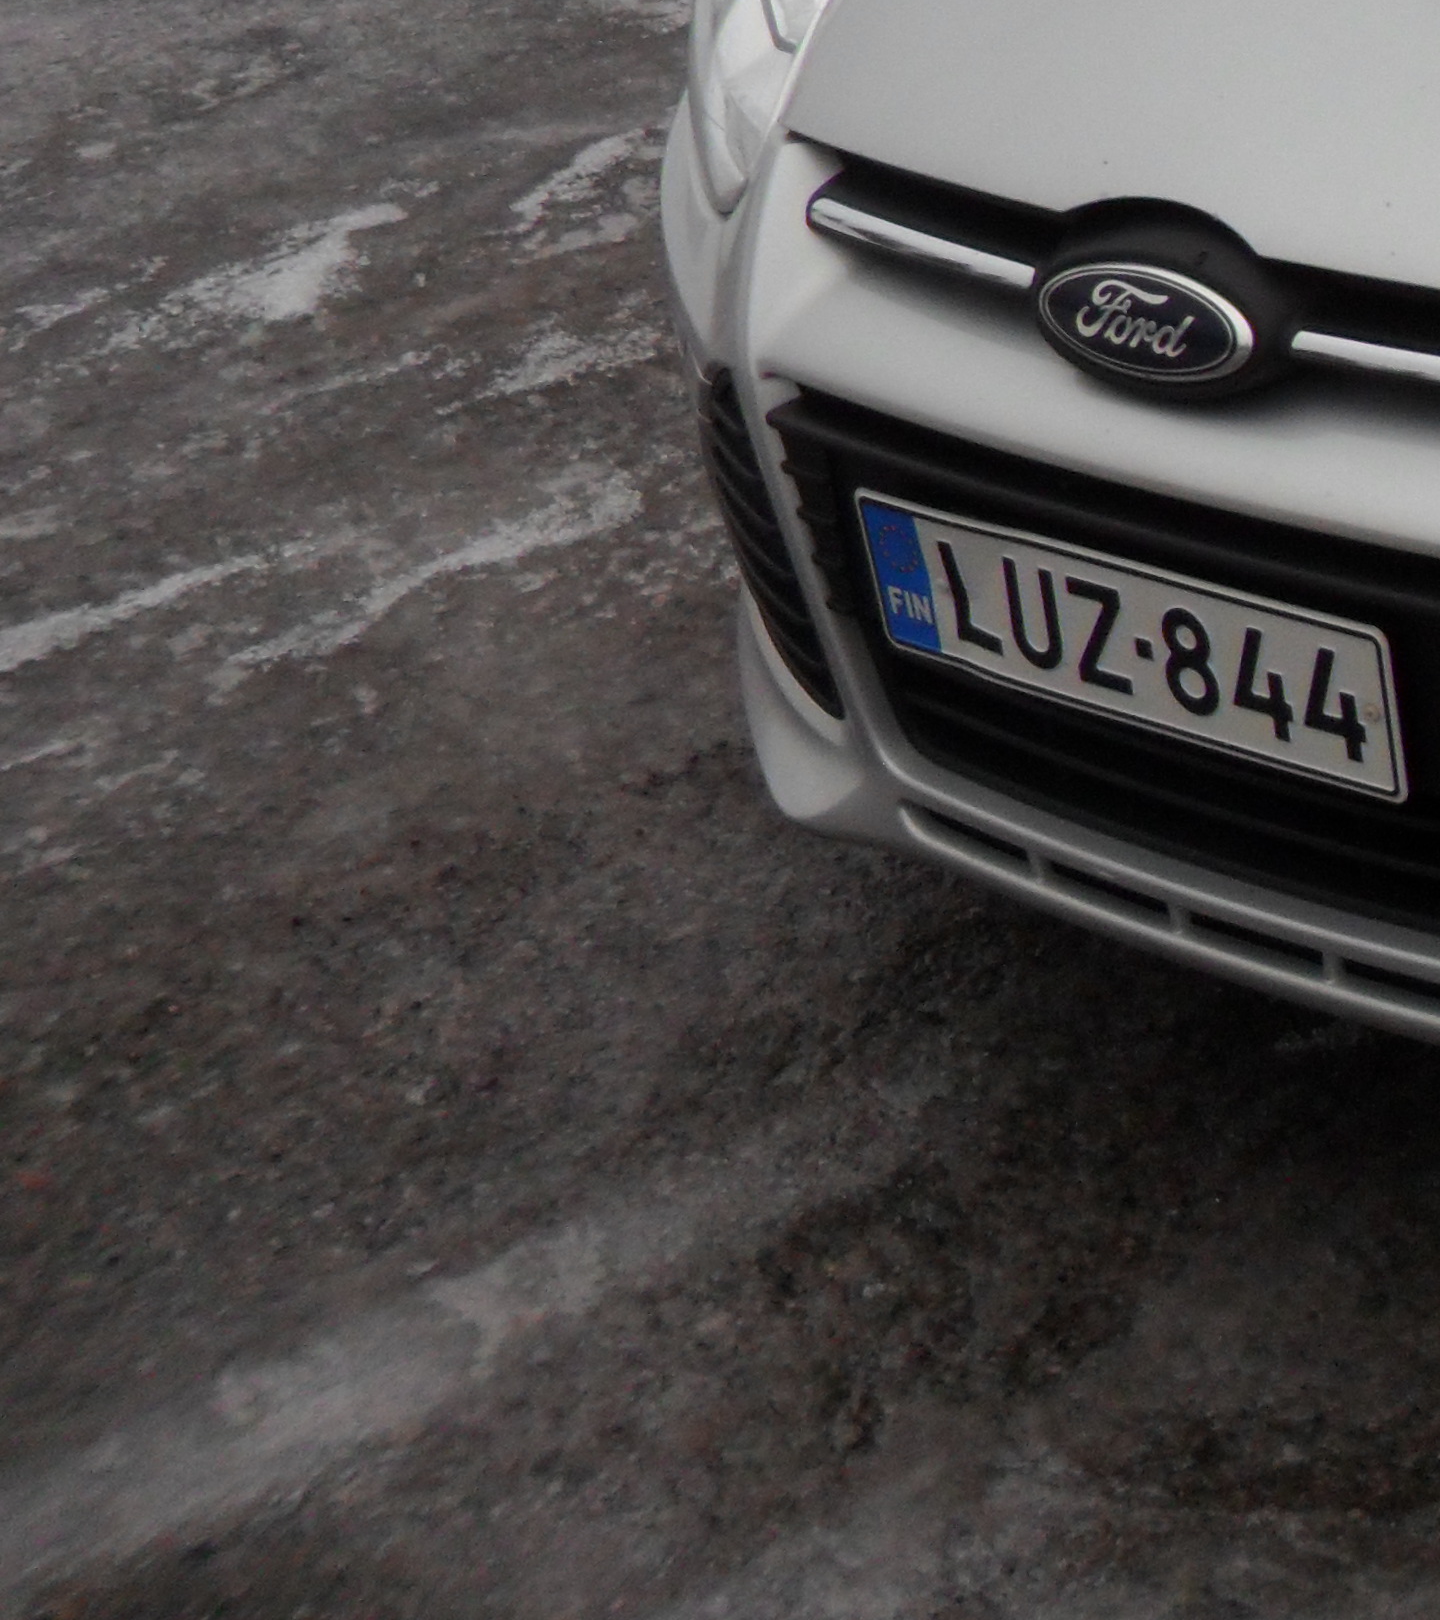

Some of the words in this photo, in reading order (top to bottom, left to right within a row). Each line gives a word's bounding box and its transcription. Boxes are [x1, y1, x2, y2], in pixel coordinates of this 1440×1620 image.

[1075, 279, 1196, 358] Ford
[887, 586, 933, 624] FIN
[937, 541, 1366, 762] LUZ-844
